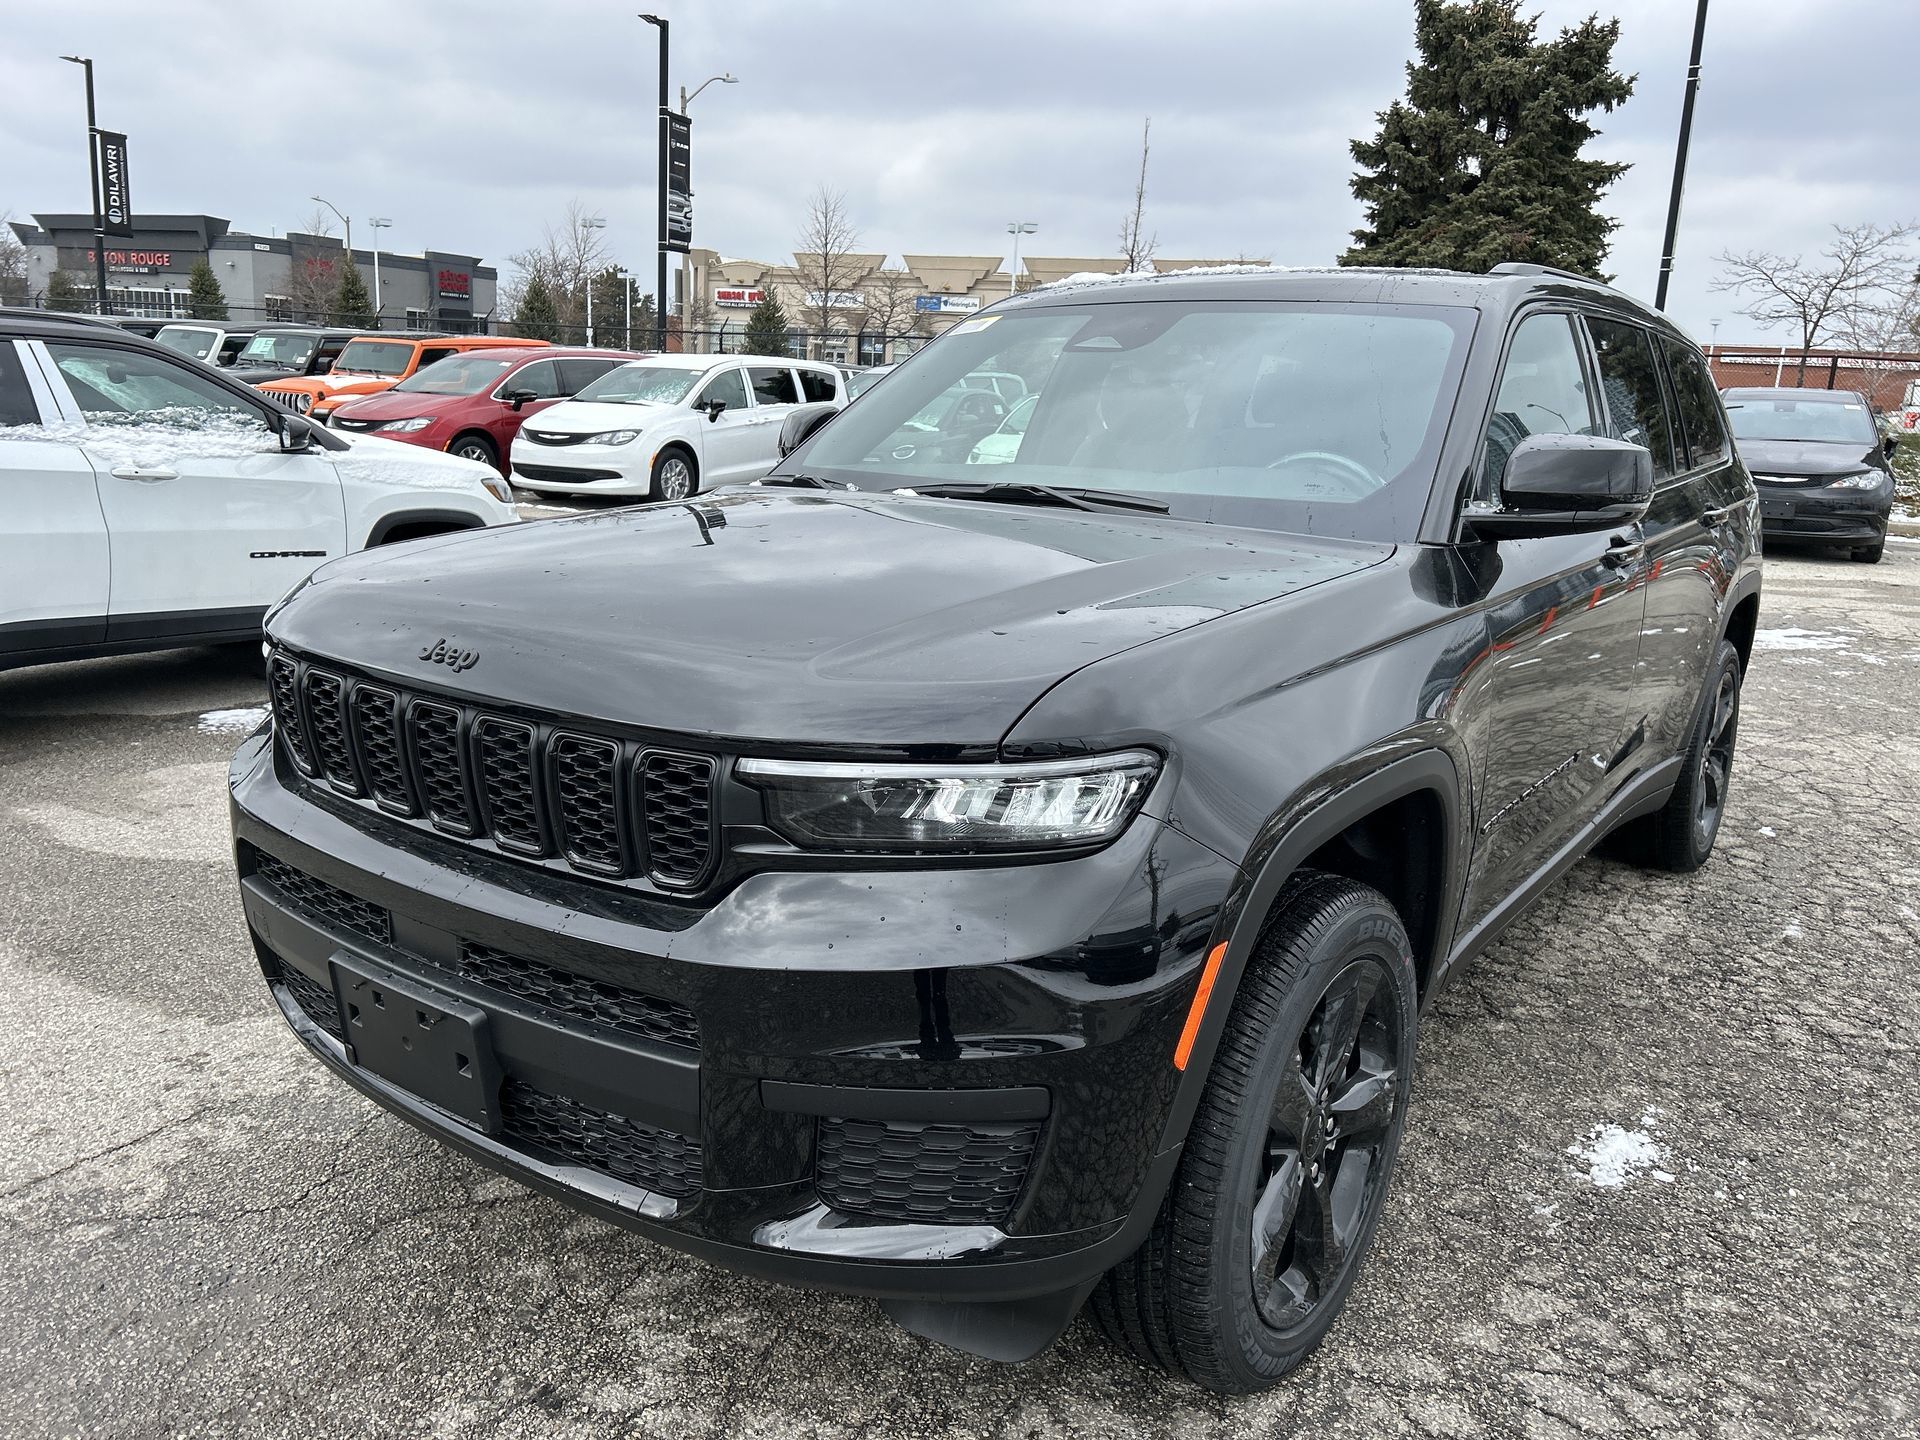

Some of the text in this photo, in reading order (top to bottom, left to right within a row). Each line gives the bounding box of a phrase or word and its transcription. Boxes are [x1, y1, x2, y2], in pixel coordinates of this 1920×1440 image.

[106, 144, 120, 206] DILAWRI
[87, 251, 171, 266] BTON ROUGE
[250, 550, 327, 558] COMPASS
[418, 637, 480, 674] Jeep
